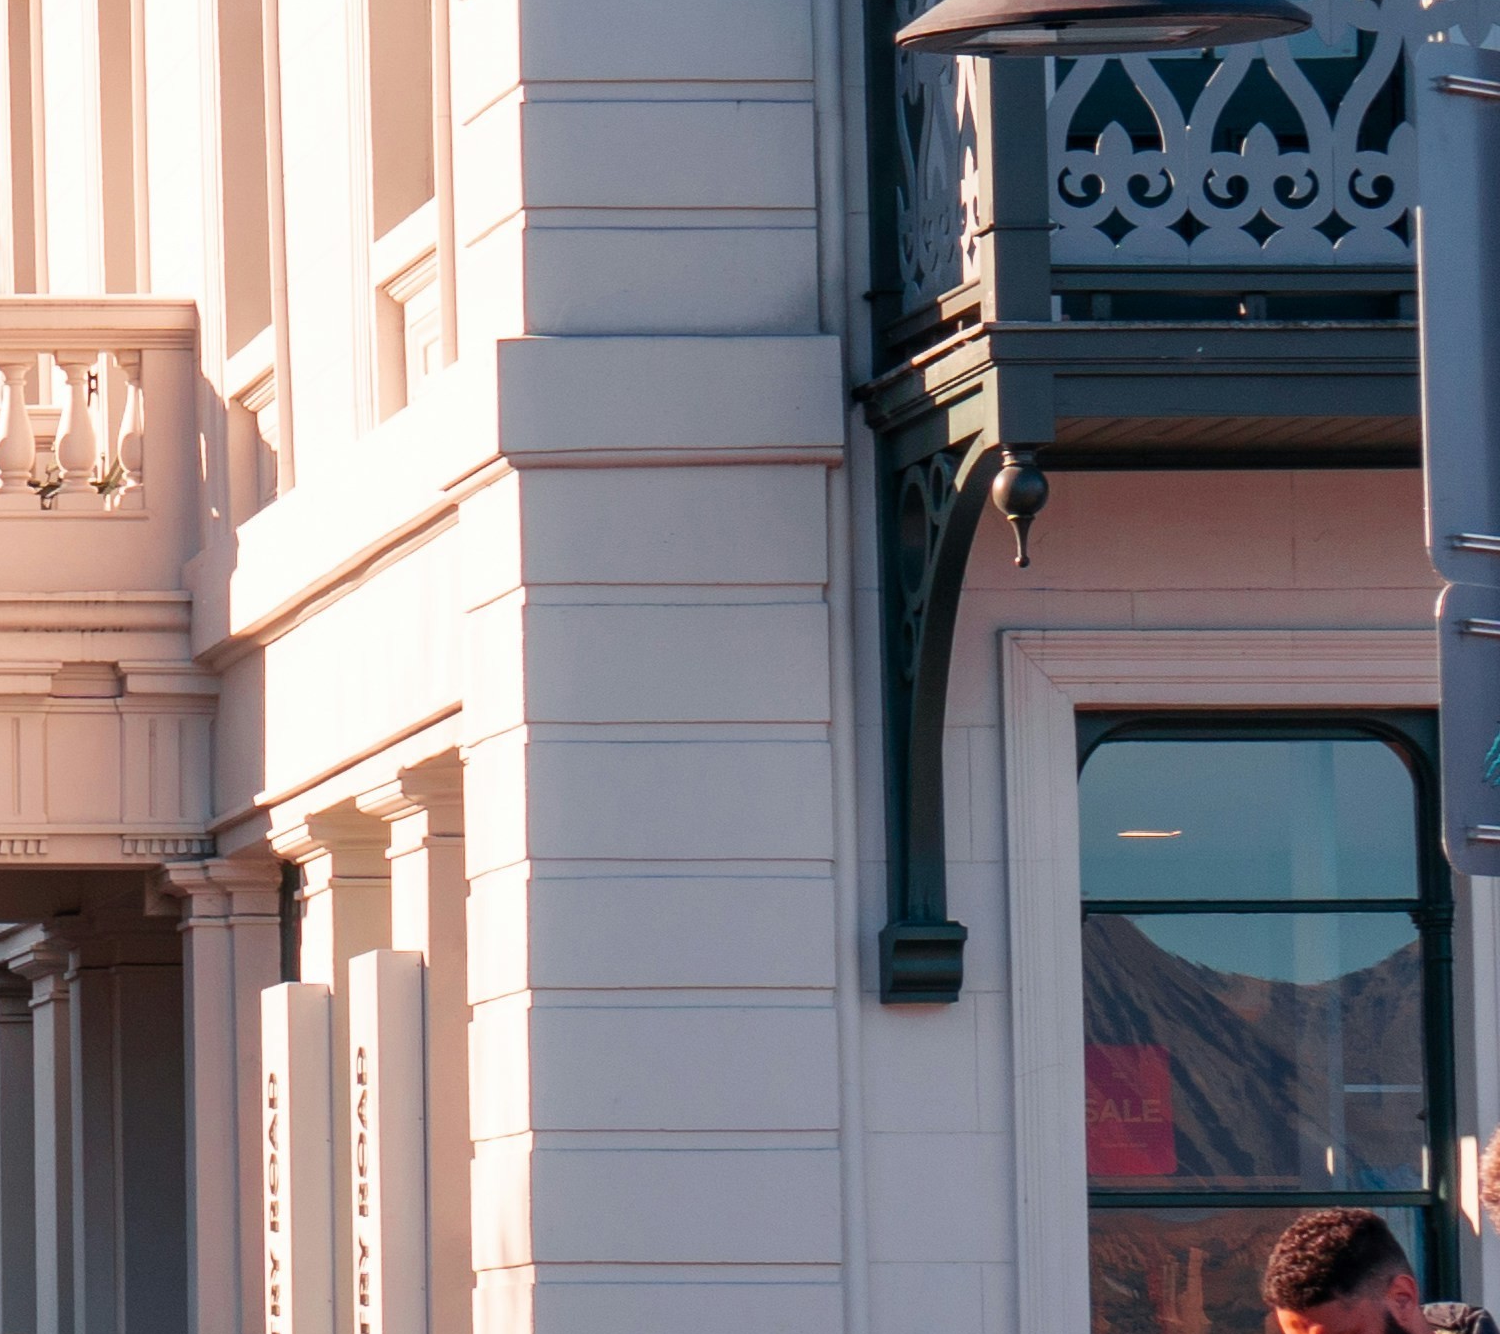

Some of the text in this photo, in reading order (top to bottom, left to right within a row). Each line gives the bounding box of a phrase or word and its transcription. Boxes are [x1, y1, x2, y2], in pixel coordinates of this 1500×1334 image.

[268, 1072, 280, 1233] ROAD
[356, 1046, 369, 1218] ROAD
[1086, 1098, 1164, 1123] SALE
